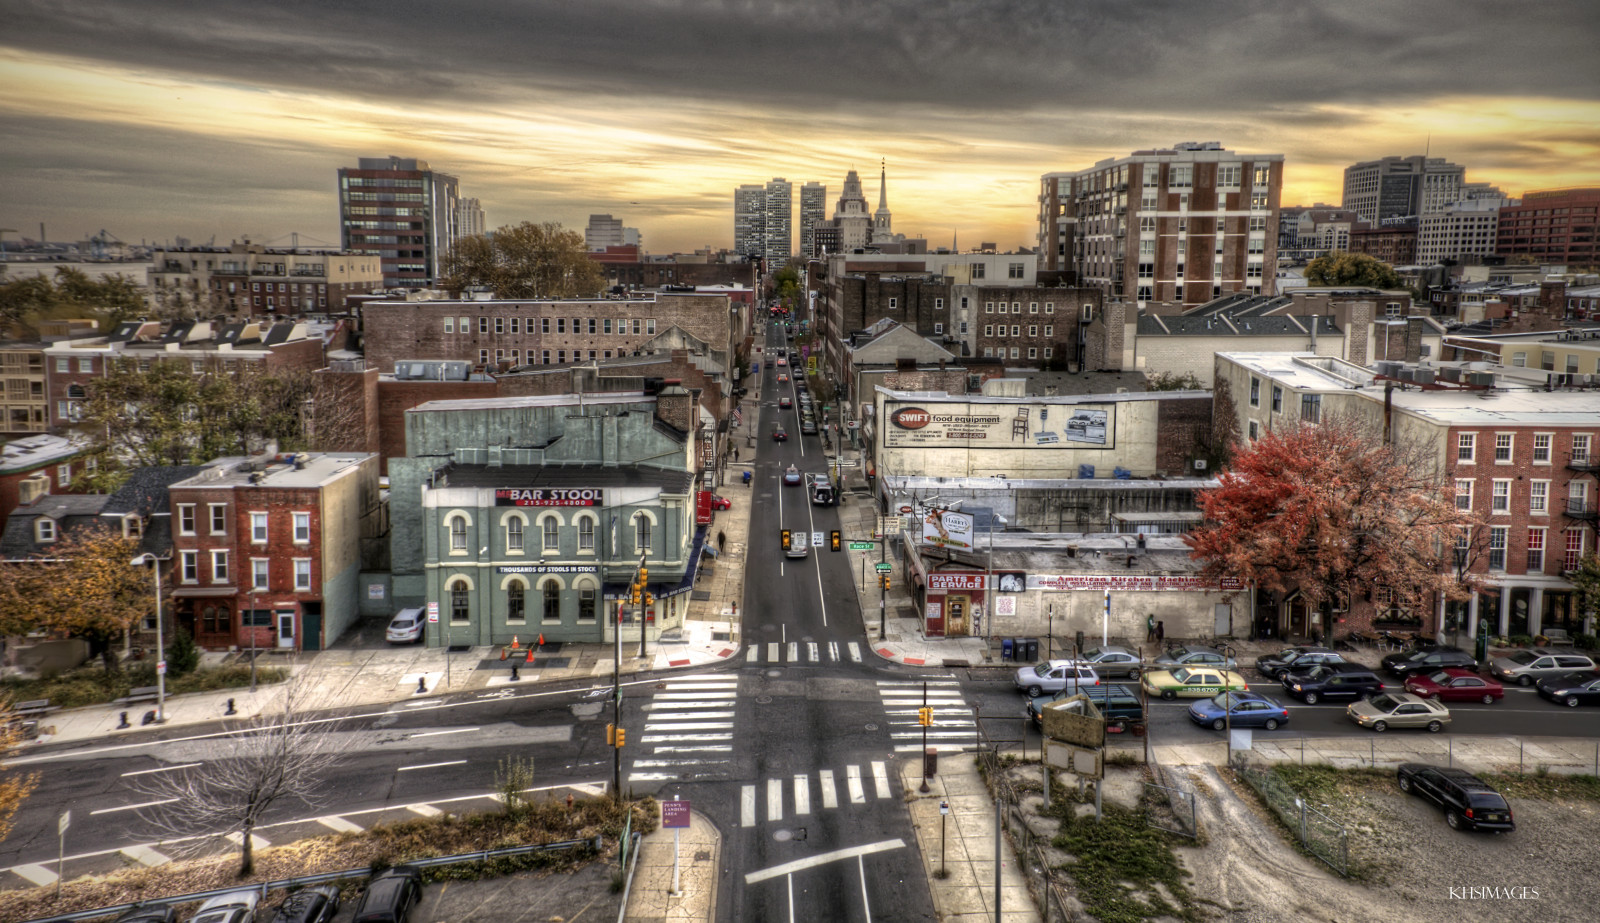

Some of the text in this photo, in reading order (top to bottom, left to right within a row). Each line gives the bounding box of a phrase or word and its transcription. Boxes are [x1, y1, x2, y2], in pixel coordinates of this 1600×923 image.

[899, 413, 930, 422] SWIFT
[954, 415, 1000, 423] equipment
[510, 489, 543, 500] BAR
[550, 489, 602, 500] STOOL
